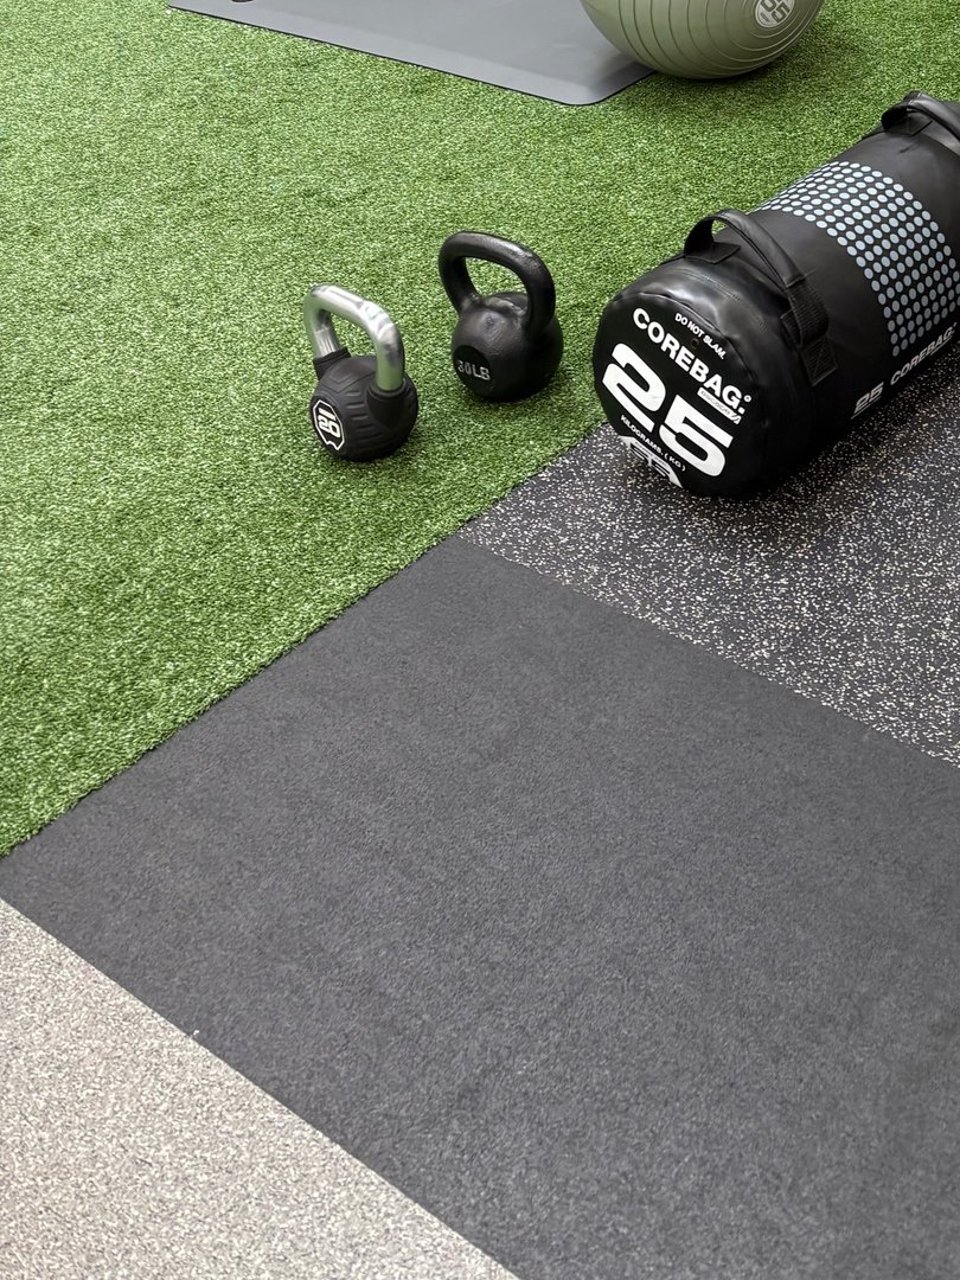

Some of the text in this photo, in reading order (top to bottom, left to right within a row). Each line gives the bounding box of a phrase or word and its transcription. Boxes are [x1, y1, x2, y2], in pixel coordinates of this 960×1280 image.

[675, 313, 687, 326] DO
[687, 321, 704, 338] NOT
[602, 343, 733, 477] 25
[853, 381, 884, 414] 25
